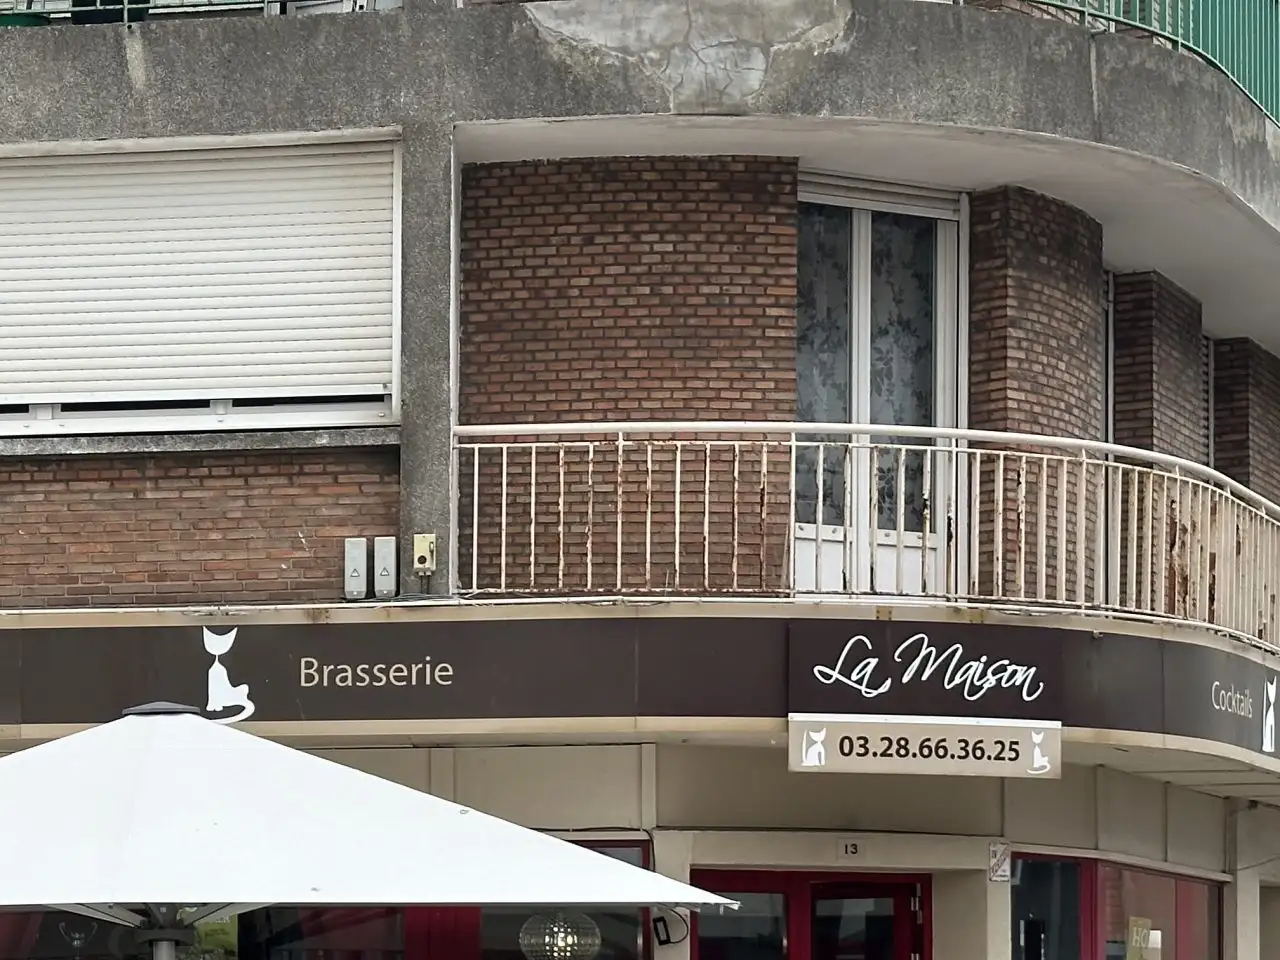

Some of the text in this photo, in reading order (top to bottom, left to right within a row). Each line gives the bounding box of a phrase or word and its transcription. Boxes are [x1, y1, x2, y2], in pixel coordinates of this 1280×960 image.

[300, 655, 454, 687] Brasserie
[813, 633, 1044, 701] La Maison
[1211, 681, 1253, 719] Cocktails
[838, 735, 1021, 762] 03.28.66.36.25
[844, 843, 859, 855] 13
